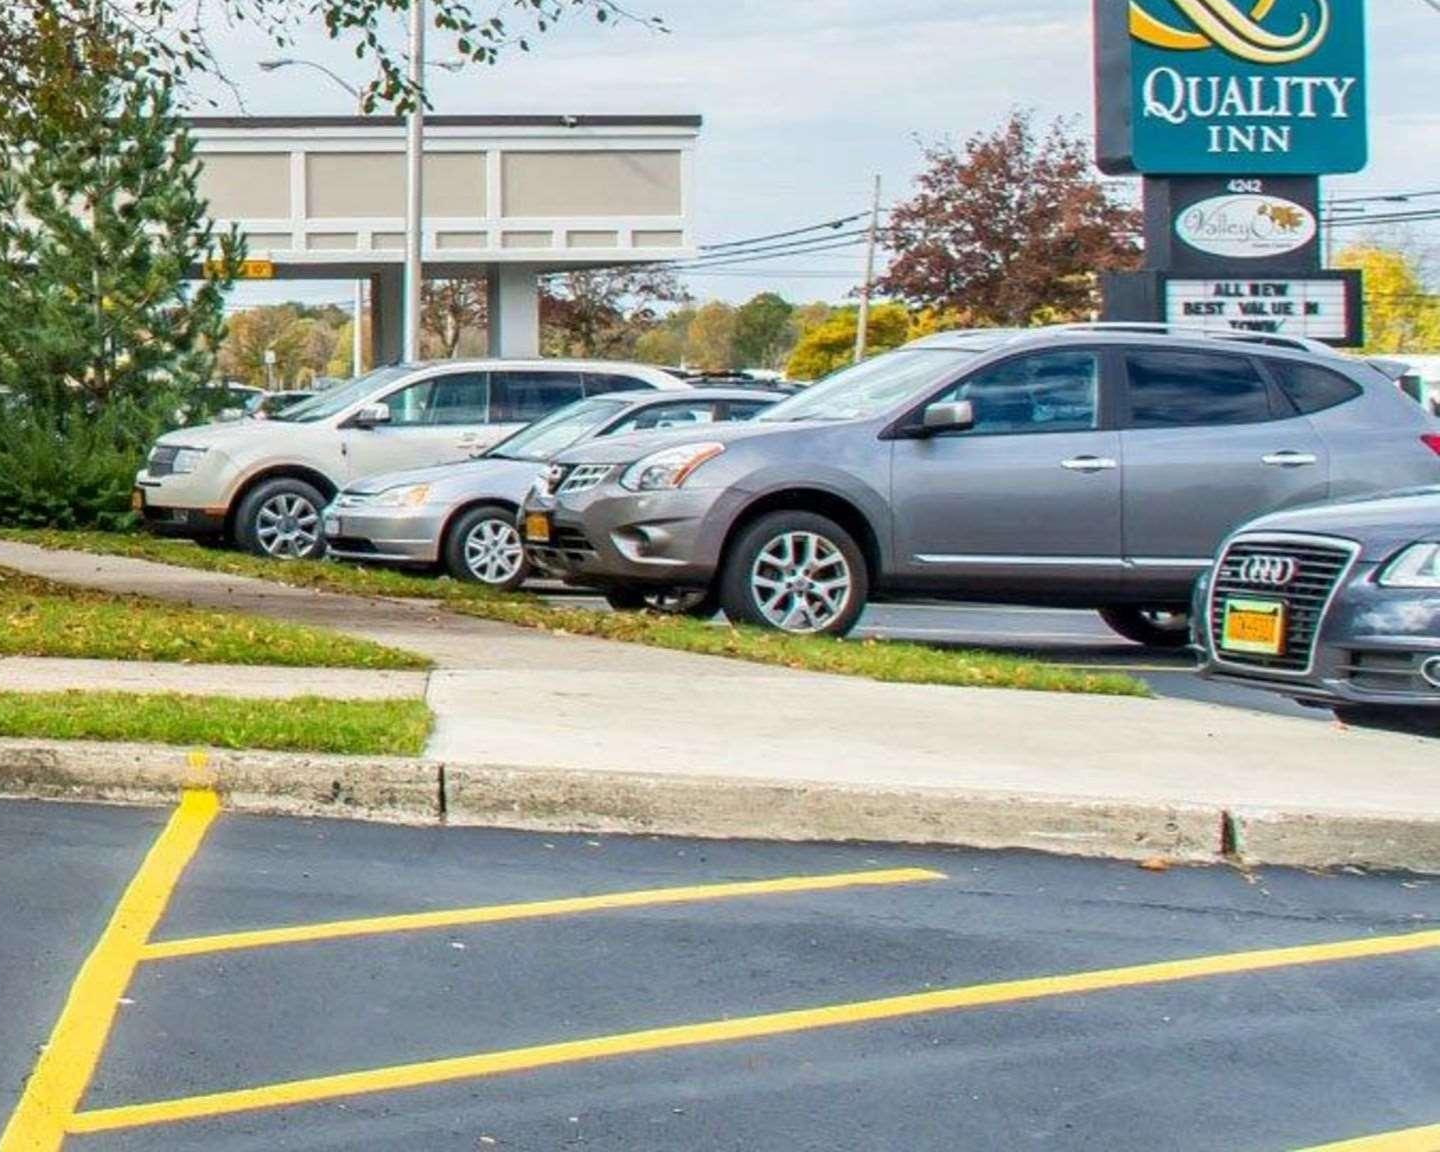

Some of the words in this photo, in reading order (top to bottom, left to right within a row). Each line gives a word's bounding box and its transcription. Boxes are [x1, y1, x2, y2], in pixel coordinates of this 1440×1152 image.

[1142, 66, 1356, 124] QUALITY
[1207, 125, 1291, 152] INN
[1227, 179, 1262, 192] 4242
[1214, 283, 1244, 297] ALL
[1249, 283, 1288, 297] NEW
[1183, 302, 1226, 315] BEST
[1239, 302, 1293, 315] VALUE
